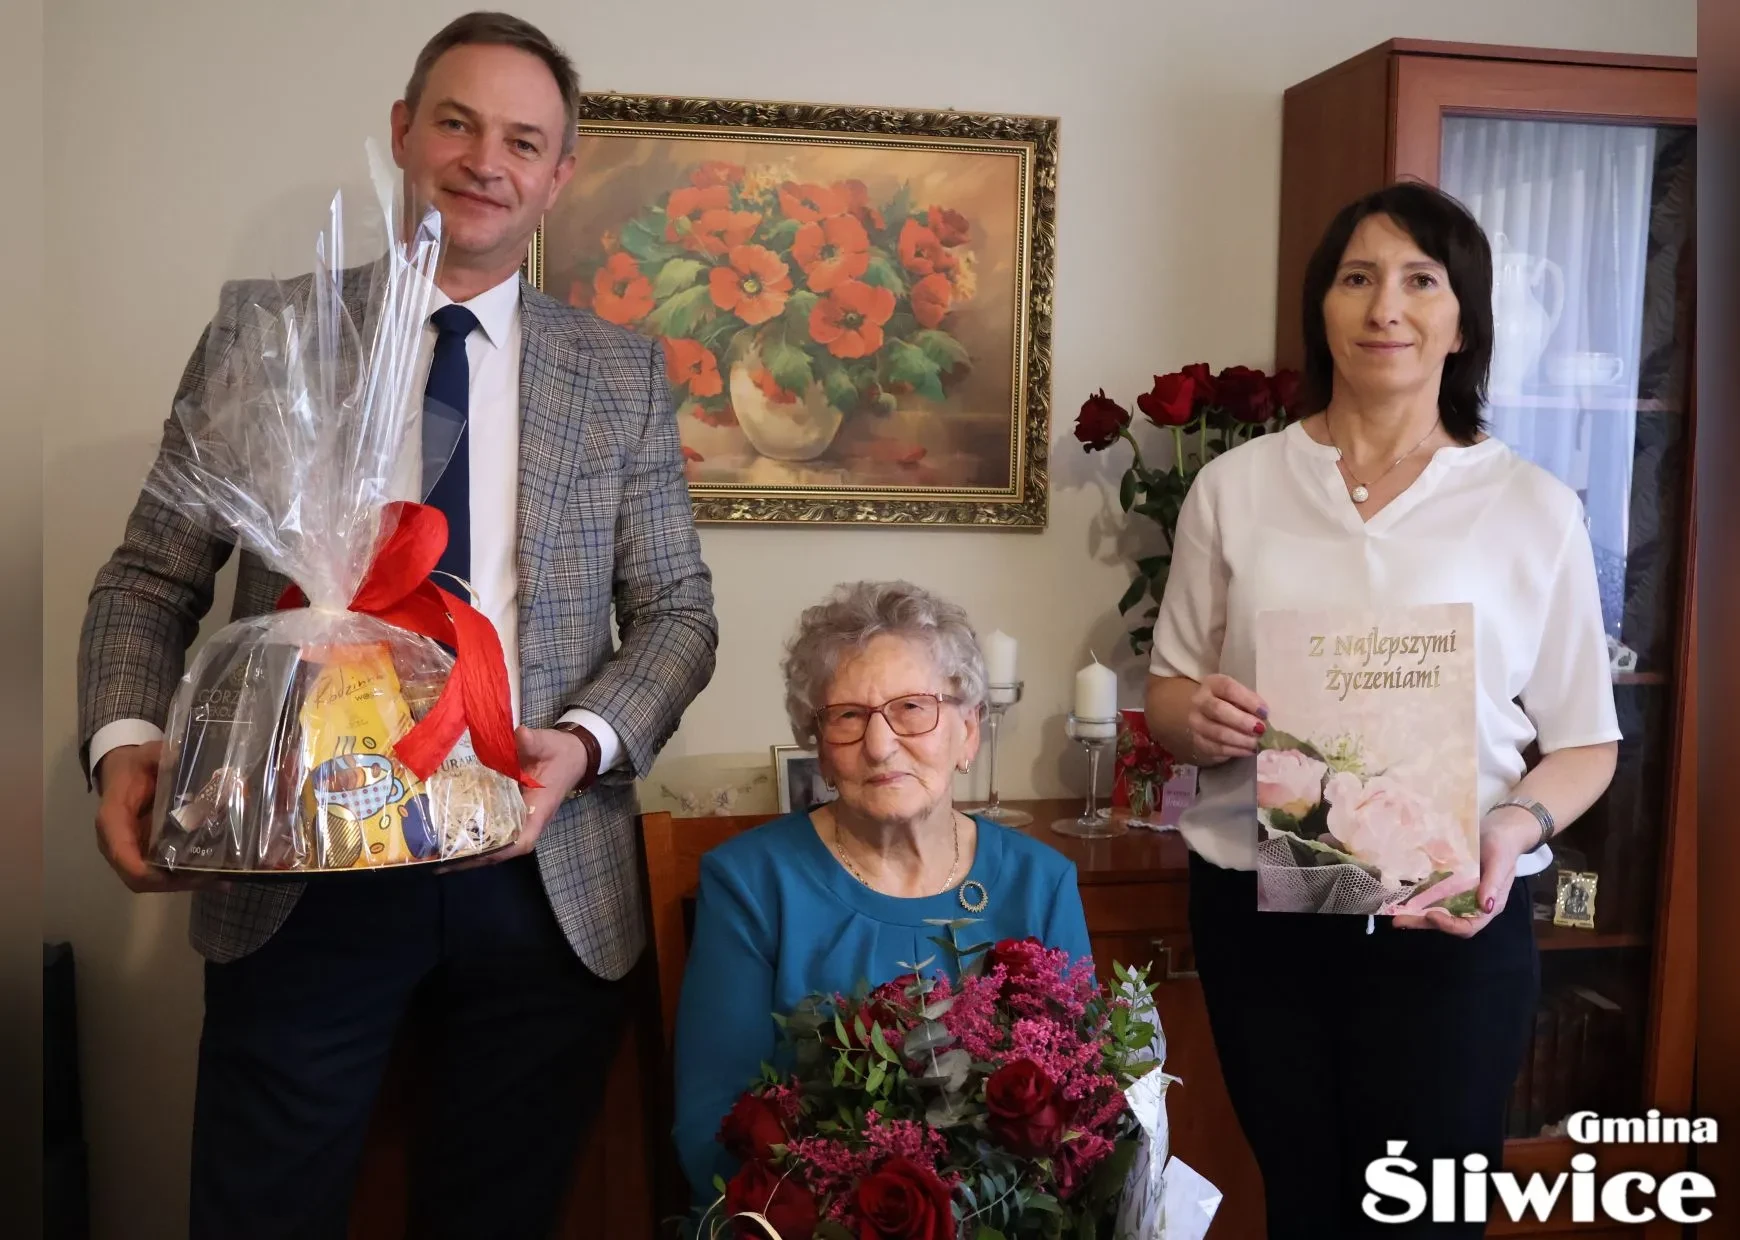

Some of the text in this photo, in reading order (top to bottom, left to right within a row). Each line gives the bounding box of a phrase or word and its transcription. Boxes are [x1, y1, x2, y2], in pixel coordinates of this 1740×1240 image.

[1308, 627, 1457, 666] Z Najlepszymi
[1325, 664, 1441, 701] Życzeniami
